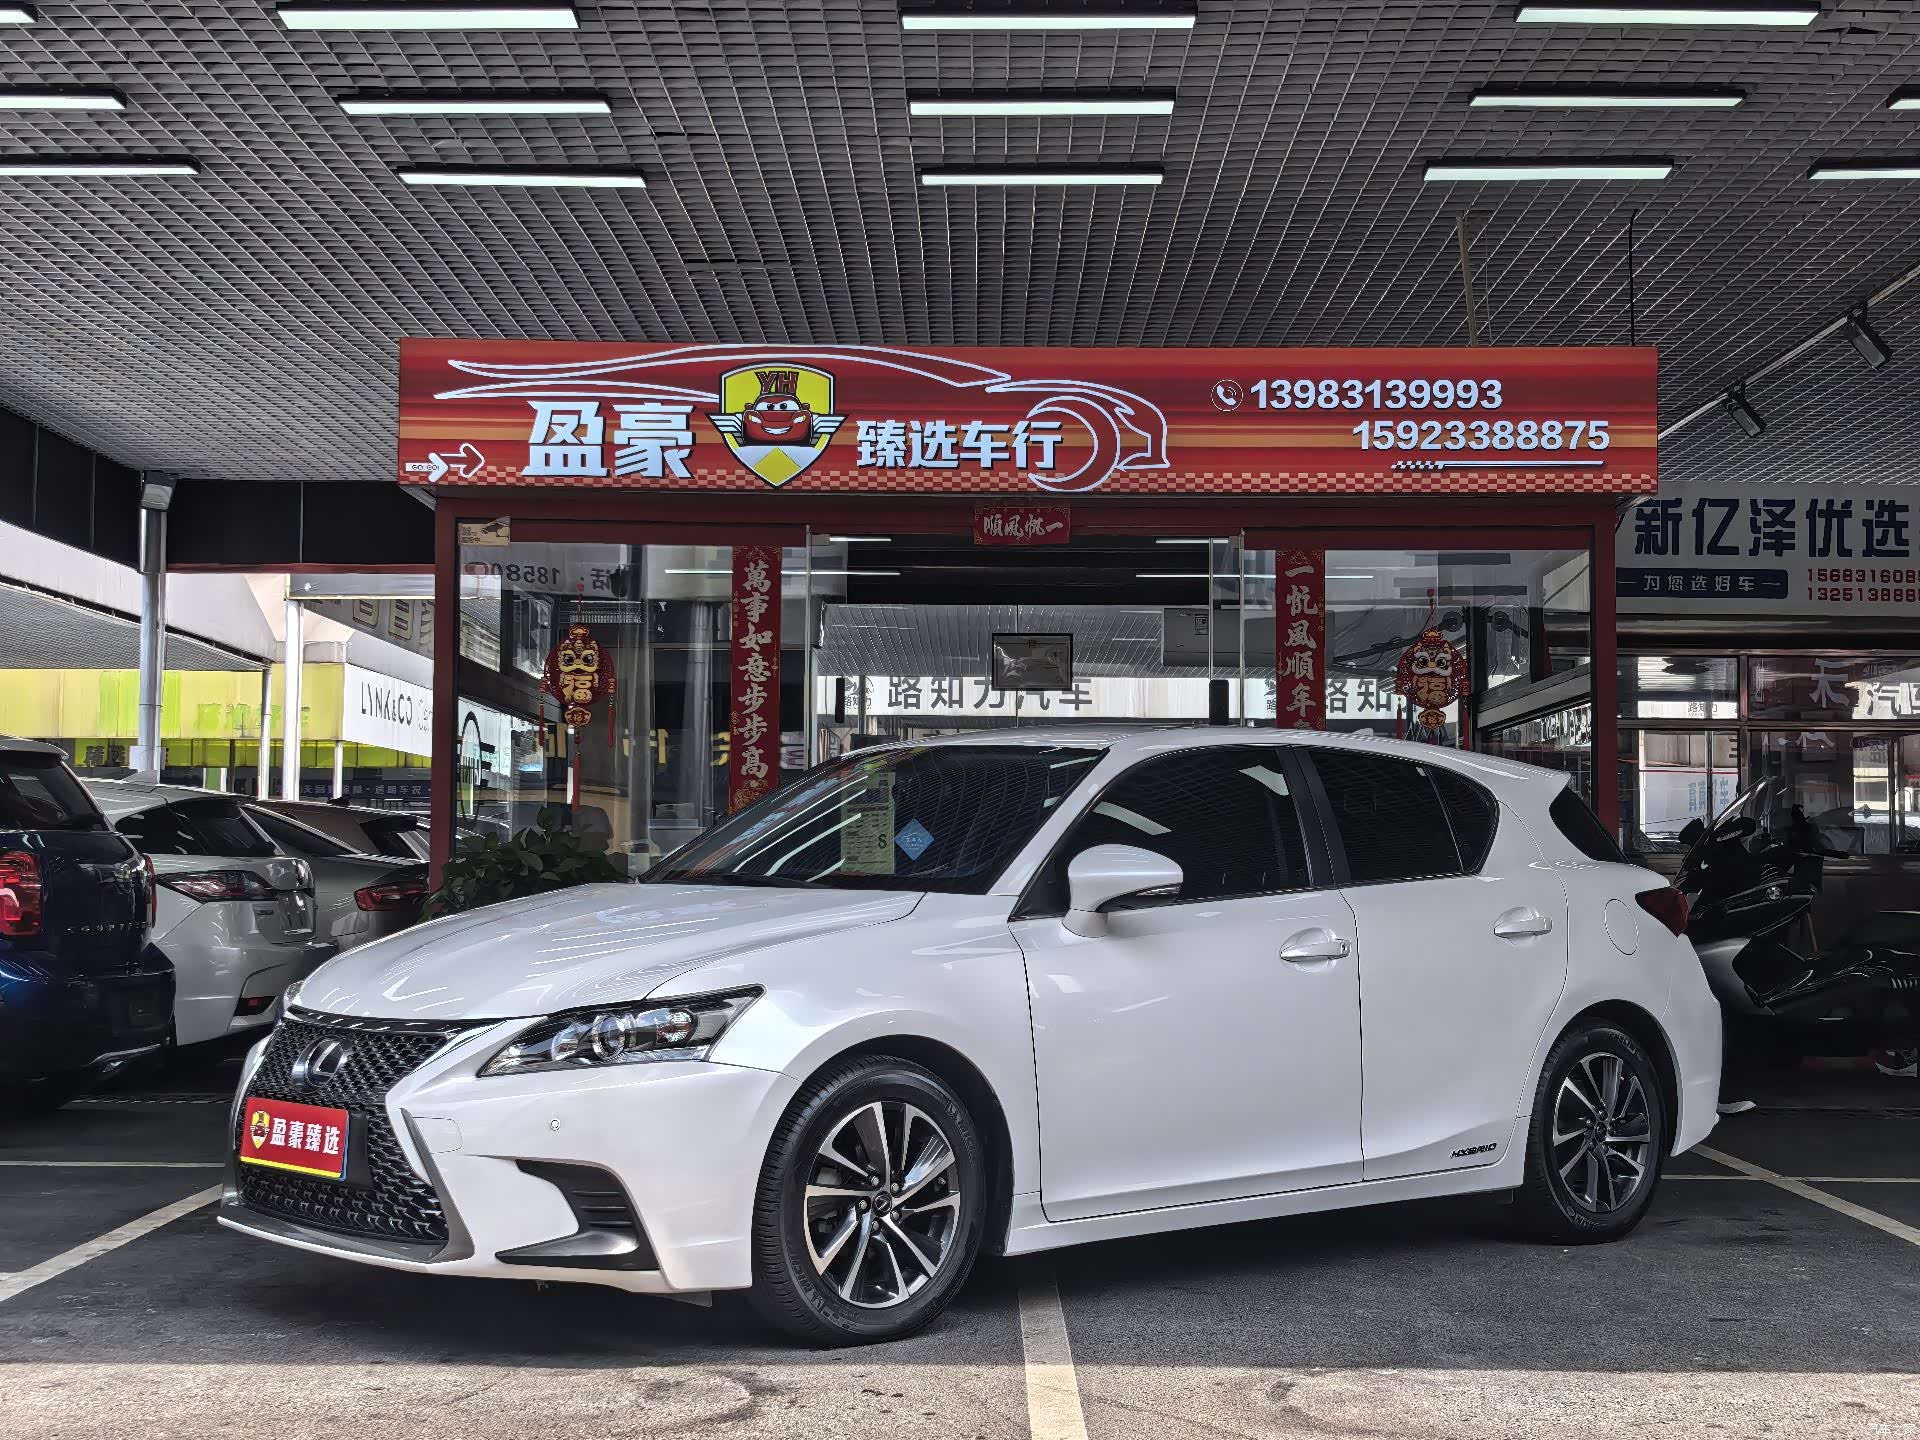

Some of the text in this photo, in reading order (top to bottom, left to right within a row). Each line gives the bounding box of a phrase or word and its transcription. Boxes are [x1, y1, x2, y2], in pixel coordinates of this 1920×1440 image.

[755, 371, 800, 394] YH
[1250, 379, 1503, 409] 13983139993
[522, 400, 695, 479] 盈豪
[856, 418, 1063, 470] 臻选车行
[1353, 420, 1611, 451] 15923388875
[1634, 497, 1910, 558] 新亿泽优选
[1643, 574, 1756, 592] 为您选好车
[1807, 568, 1920, 584] 156831608
[1807, 586, 1920, 603] 132513888
[269, 1117, 341, 1155] 盈豪臻选
